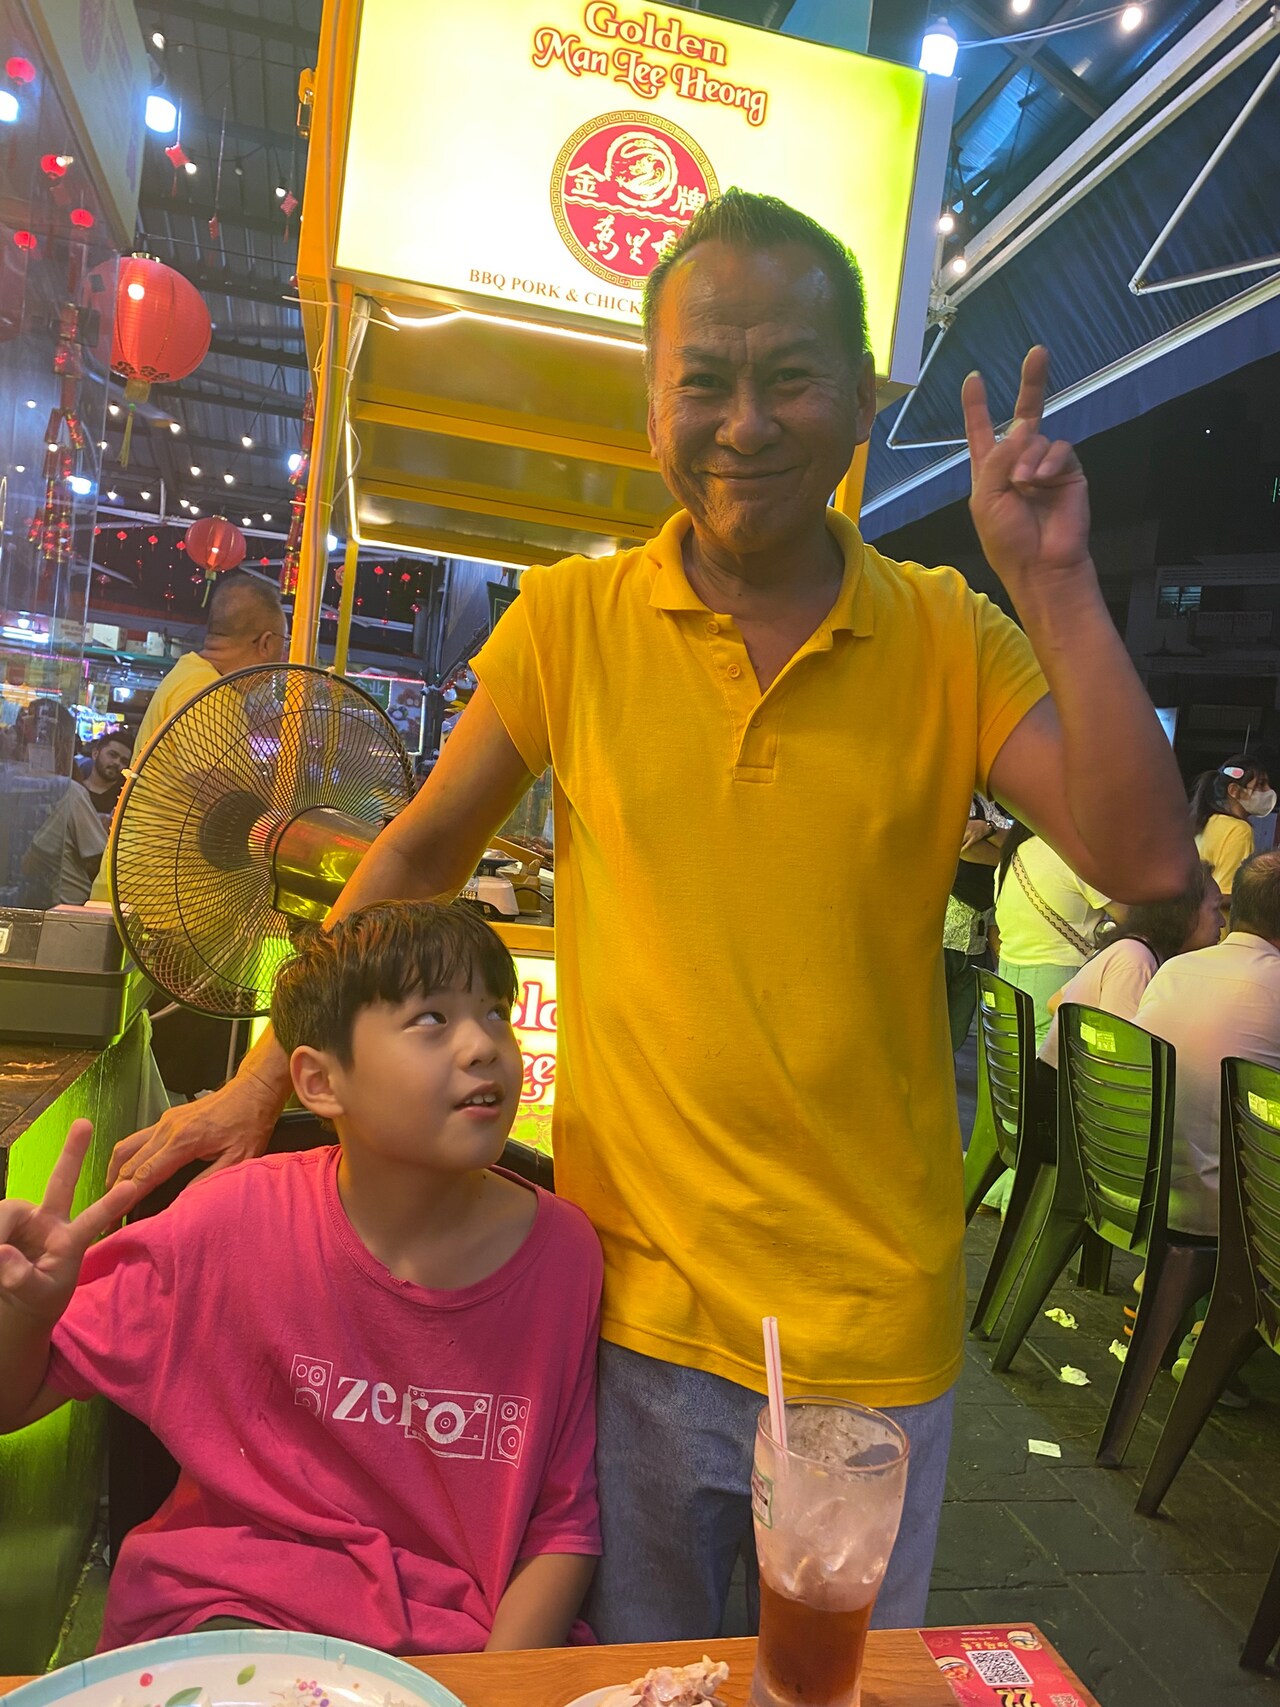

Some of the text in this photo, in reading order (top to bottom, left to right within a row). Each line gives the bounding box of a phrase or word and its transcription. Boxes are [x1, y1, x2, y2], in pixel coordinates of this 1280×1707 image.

[585, 1, 726, 65] Golden
[533, 27, 767, 126] Man Lee Heong
[567, 163, 606, 198] 金
[469, 269, 506, 290] BBQ
[511, 277, 560, 299] PORK
[565, 288, 578, 302] &
[332, 1376, 466, 1444] zero
